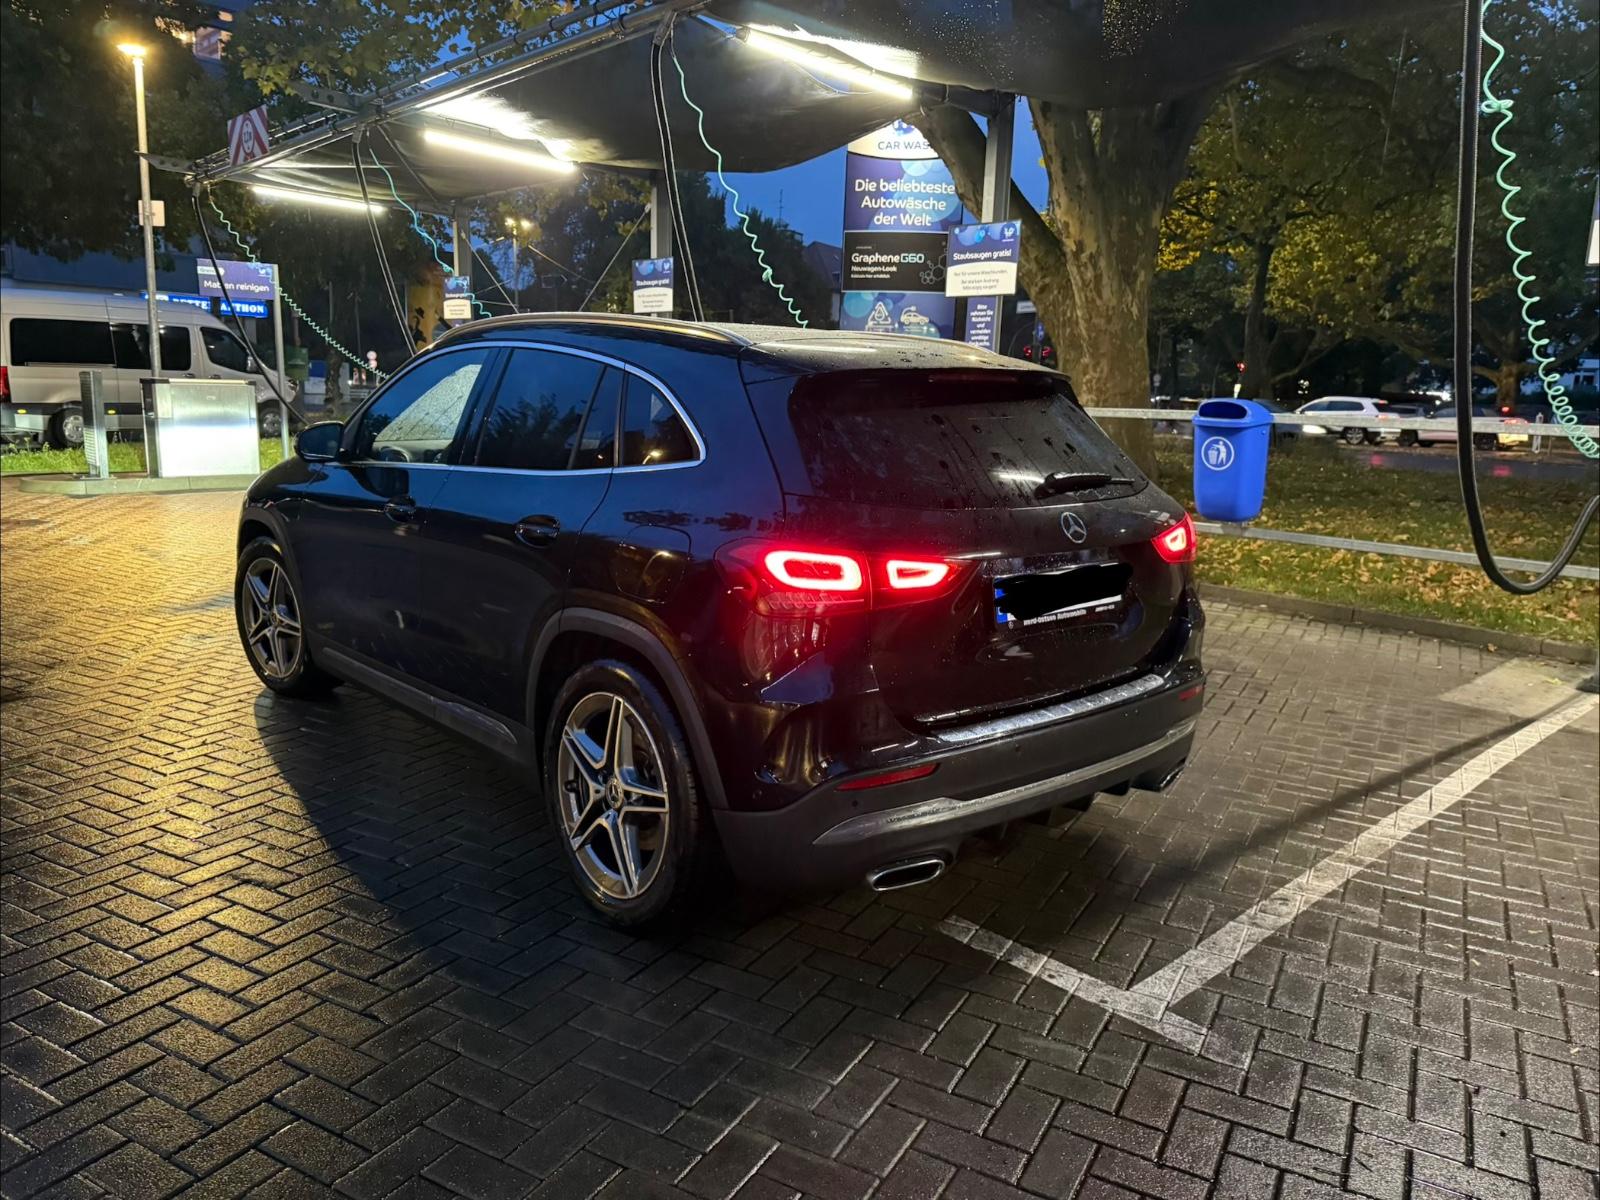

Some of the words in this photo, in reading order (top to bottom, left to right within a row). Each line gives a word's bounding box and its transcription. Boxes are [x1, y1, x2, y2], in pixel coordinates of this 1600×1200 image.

[878, 141, 900, 150] CAR
[904, 141, 930, 150] WAS
[855, 179, 877, 192] Die
[880, 179, 956, 194] beliebteste
[861, 196, 946, 210] Autowäsche
[874, 212, 897, 225] der
[900, 213, 932, 226] Welt
[953, 251, 992, 260] Staubsaugen
[992, 248, 1012, 259] gratis!
[203, 280, 235, 290] Maten
[236, 283, 270, 293] reinigen
